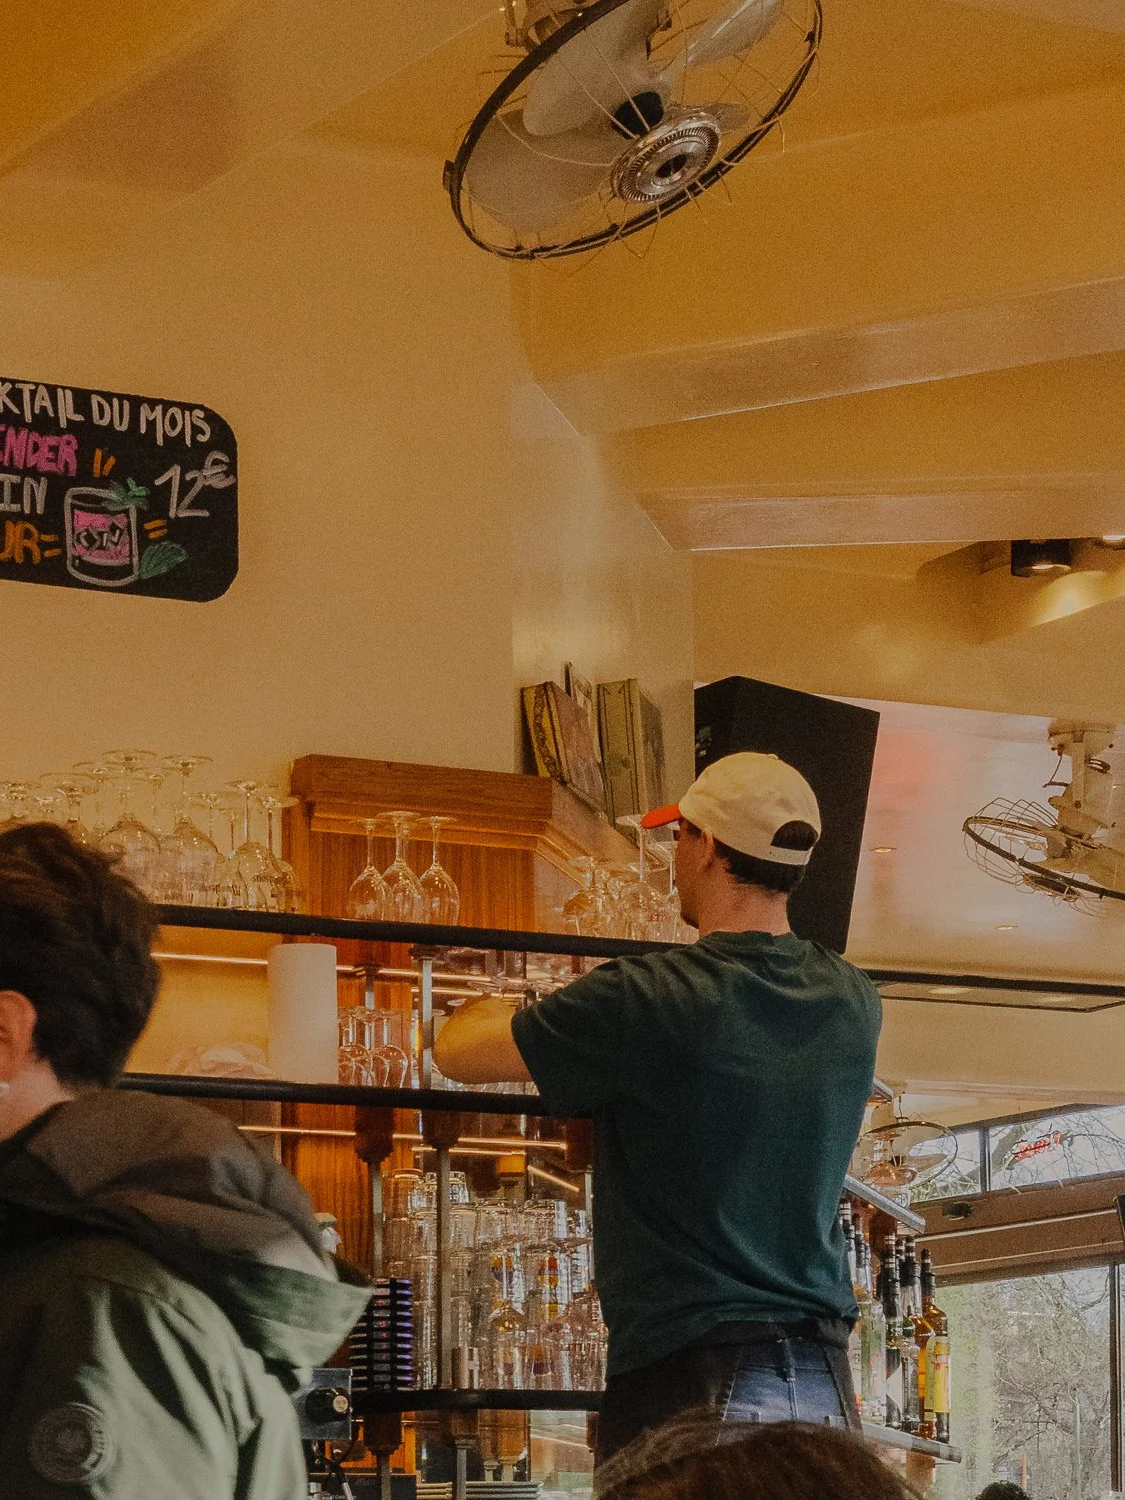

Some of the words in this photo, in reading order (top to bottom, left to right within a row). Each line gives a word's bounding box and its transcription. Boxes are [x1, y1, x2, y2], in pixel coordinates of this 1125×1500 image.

[91, 394, 129, 431] DU
[140, 405, 211, 447] MOIS
[155, 450, 236, 518] 12€
